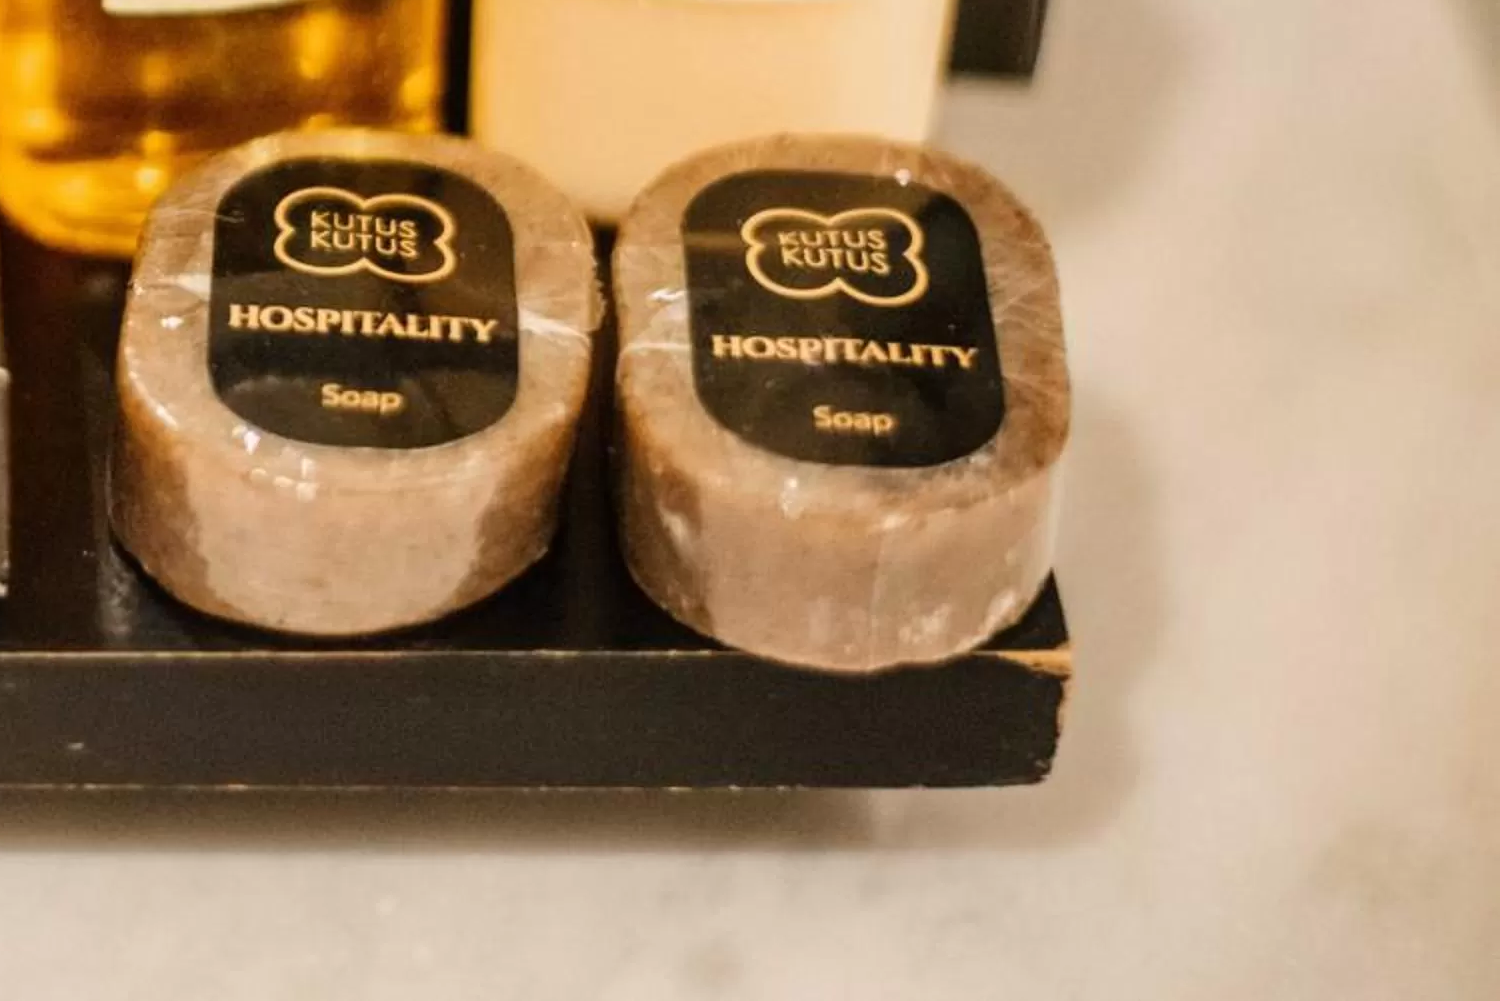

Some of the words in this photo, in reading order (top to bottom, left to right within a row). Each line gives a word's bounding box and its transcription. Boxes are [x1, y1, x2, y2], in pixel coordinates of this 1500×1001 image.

[311, 210, 417, 238] KUTUS
[311, 231, 419, 259] KUTUS
[778, 229, 886, 250] KUTUS
[781, 248, 891, 275] KUTUS
[228, 304, 498, 344] HOSPITALITY
[711, 334, 979, 369] HOSPITALITY
[321, 383, 403, 415] Soap
[813, 405, 896, 435] Soap
